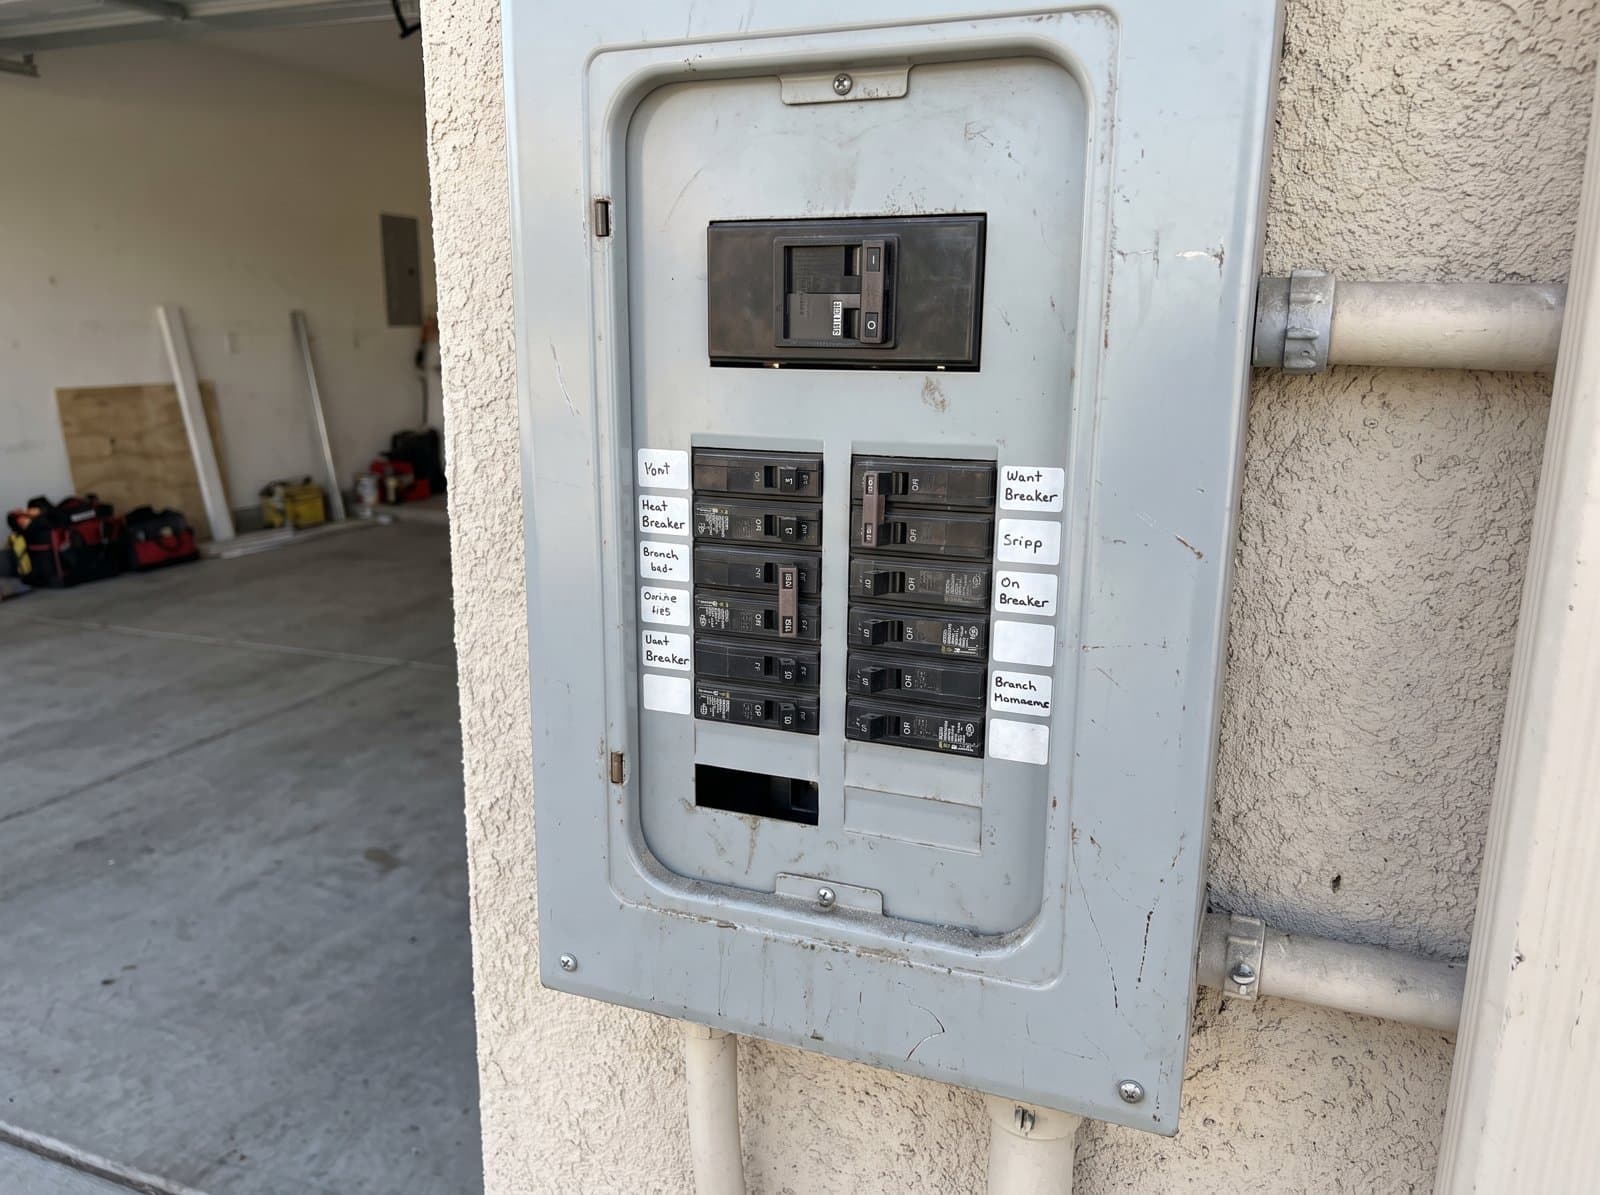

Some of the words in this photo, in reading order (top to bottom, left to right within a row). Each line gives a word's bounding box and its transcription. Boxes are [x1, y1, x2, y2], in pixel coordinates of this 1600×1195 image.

[1006, 470, 1043, 482] Want
[1004, 487, 1059, 503] Breaker
[642, 499, 668, 512] Heat
[642, 515, 686, 530] Breaker
[1001, 577, 1020, 589] On
[999, 592, 1050, 608] Breaker
[646, 650, 690, 666] Breaker
[994, 676, 1037, 692] Branch
